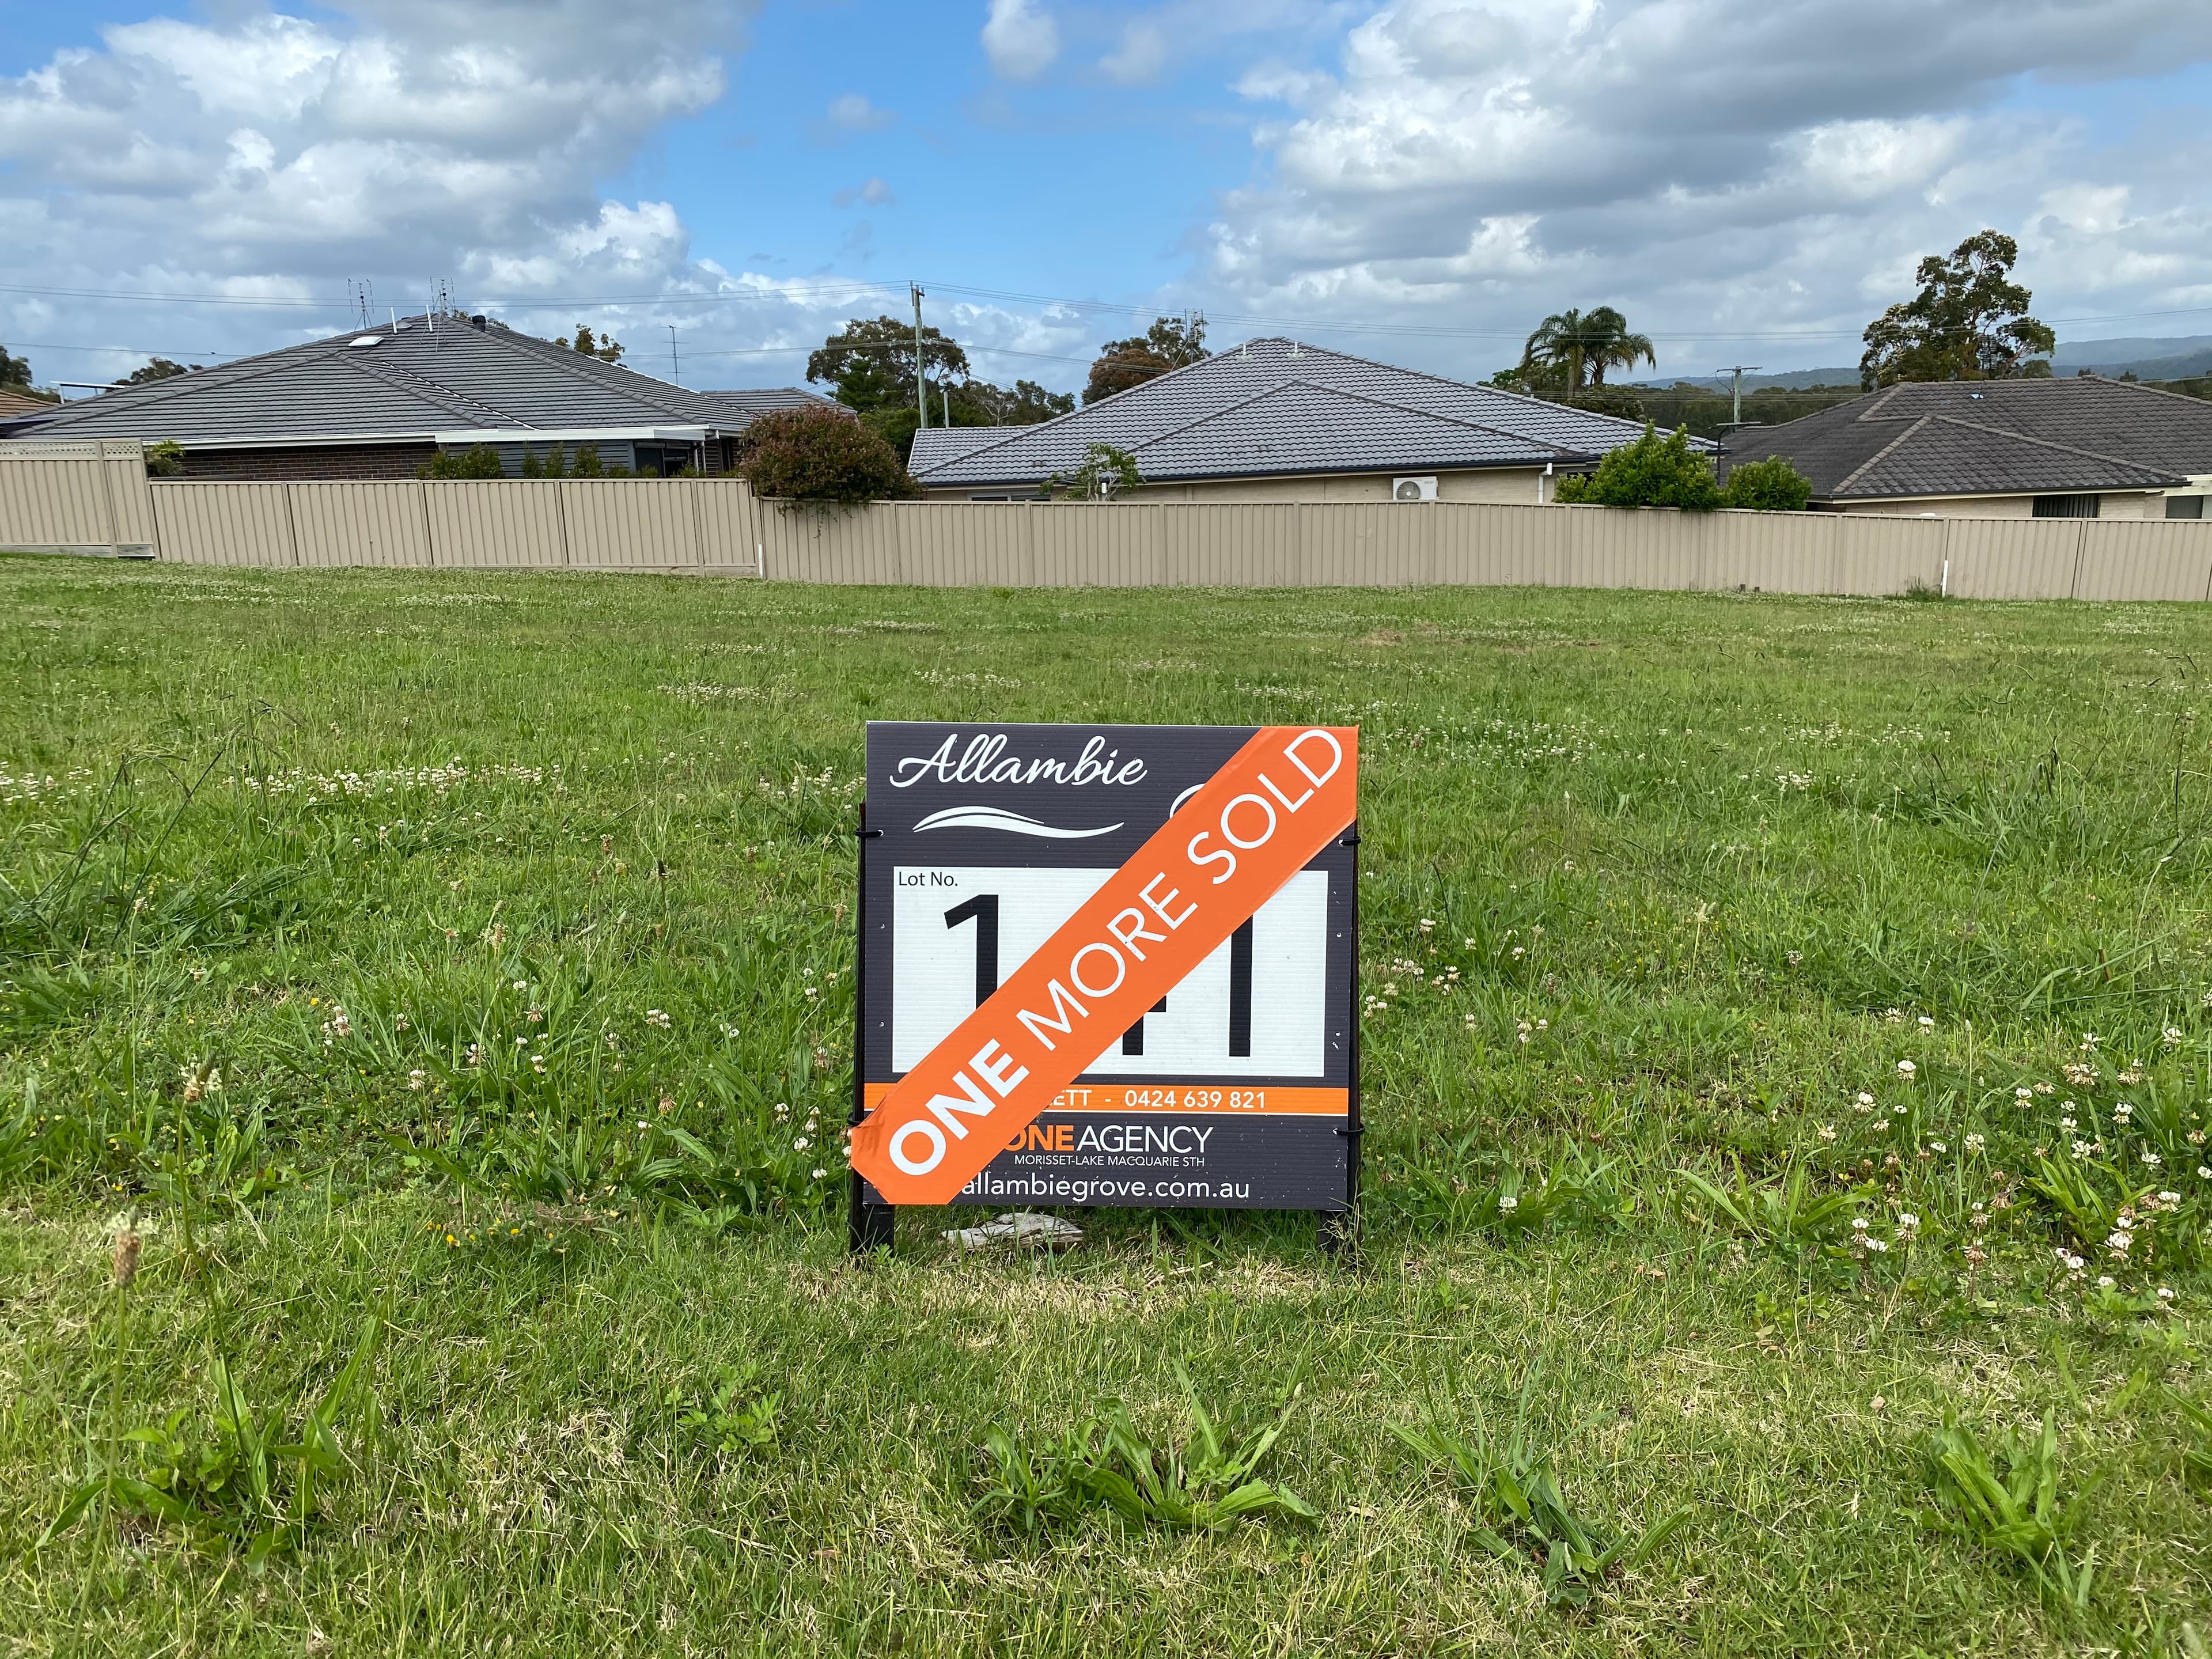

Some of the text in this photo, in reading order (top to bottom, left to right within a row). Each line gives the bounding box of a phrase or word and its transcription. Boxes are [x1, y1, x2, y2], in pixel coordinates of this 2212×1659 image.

[889, 733, 1147, 787] Allambie
[899, 871, 958, 887] Lot No.
[889, 729, 1342, 1176] ONE MORE SOLD
[1050, 1089, 1092, 1107] ETT
[1124, 1090, 1176, 1107] 0424
[1183, 1090, 1222, 1108] 639
[1229, 1091, 1266, 1109] 821
[1014, 1154, 1205, 1167] MORISSET-LAKE MACQUARIE STH
[961, 1172, 1249, 1202] allambiegrove.com.au
